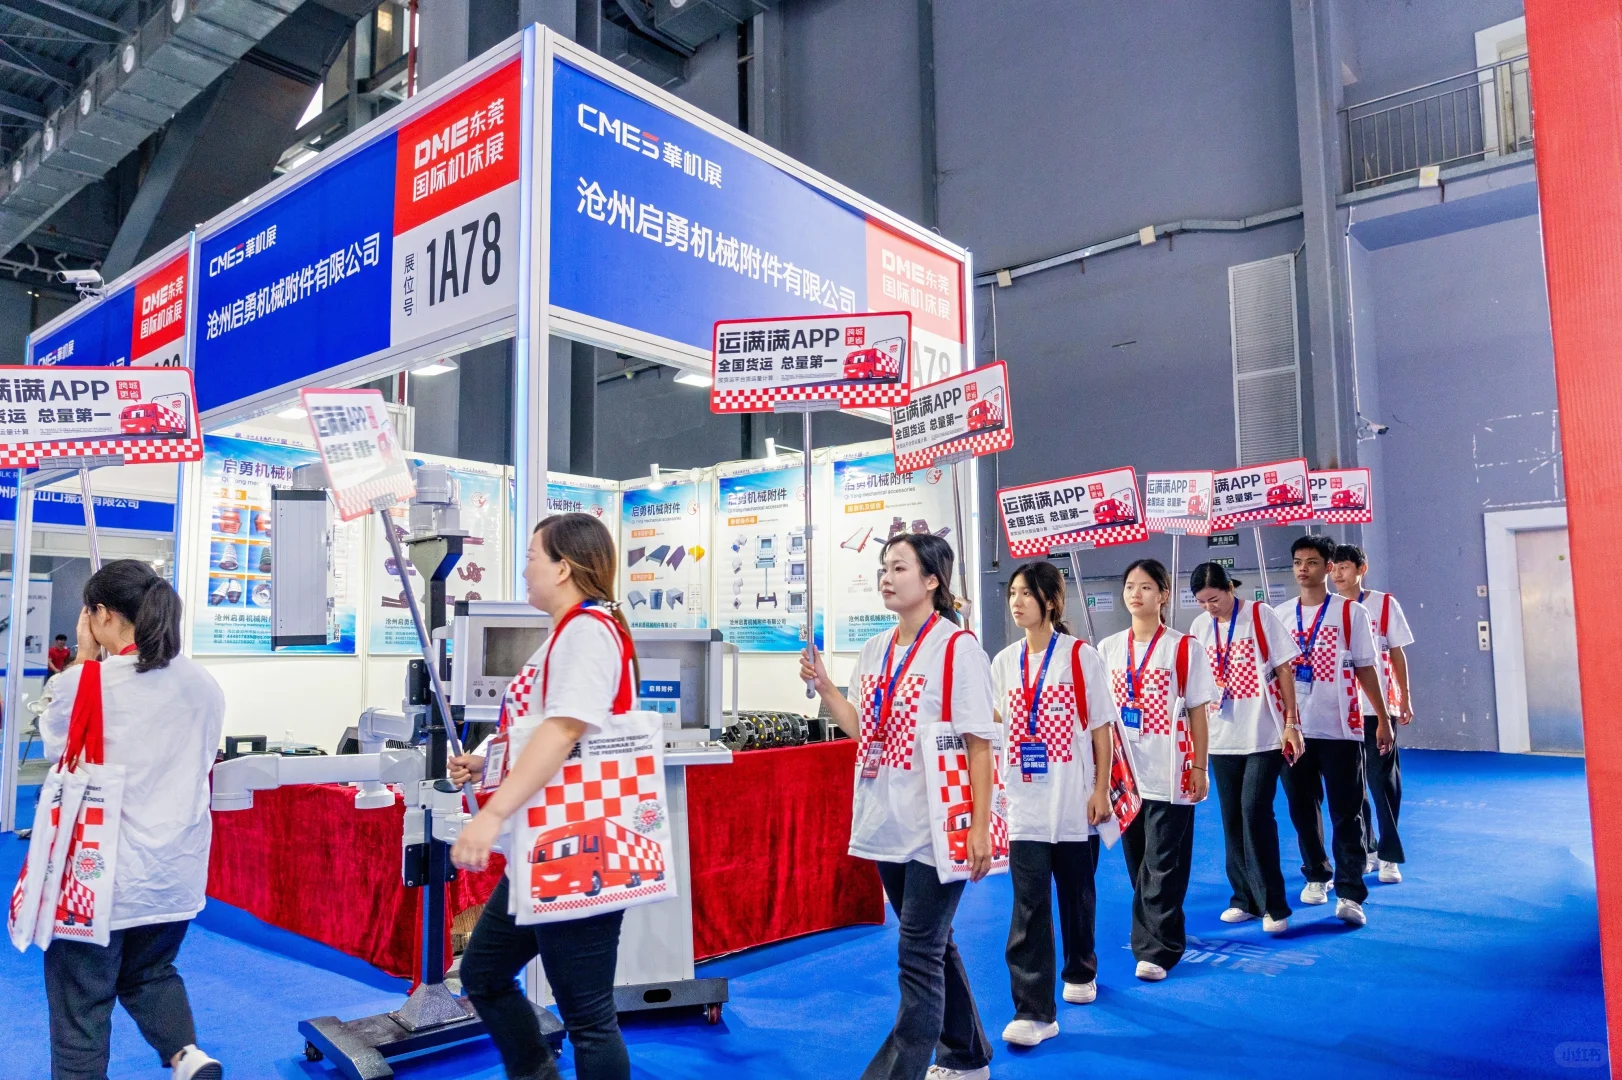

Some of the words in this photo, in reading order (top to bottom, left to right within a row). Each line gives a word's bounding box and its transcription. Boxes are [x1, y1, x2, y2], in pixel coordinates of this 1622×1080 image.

[413, 132, 504, 202] 国际机床展
[576, 176, 856, 313] 沧州启勇机械附件有限公司
[426, 211, 501, 307] 1A78
[206, 232, 380, 340] 沧州启勇机械附件有限公司
[403, 253, 415, 317] 展位号
[883, 274, 950, 320] 国际机床展
[140, 299, 183, 339] 国际机床展
[719, 328, 840, 354] 运满满APP
[718, 358, 773, 373] 全国货运
[781, 355, 838, 370] 总量第一
[119, 390, 139, 399] 更省
[0, 408, 27, 424] 运
[38, 408, 111, 424] 总量第一
[895, 422, 926, 440] 全国货运
[929, 413, 963, 431] 总量第一
[888, 486, 916, 494] accessories
[1002, 486, 1086, 516] 运满满APP
[1226, 492, 1262, 504] 总量第一
[631, 502, 681, 518] 启勇机械附件
[1007, 513, 1046, 529] 全国货运
[1049, 508, 1089, 522] 总量第一
